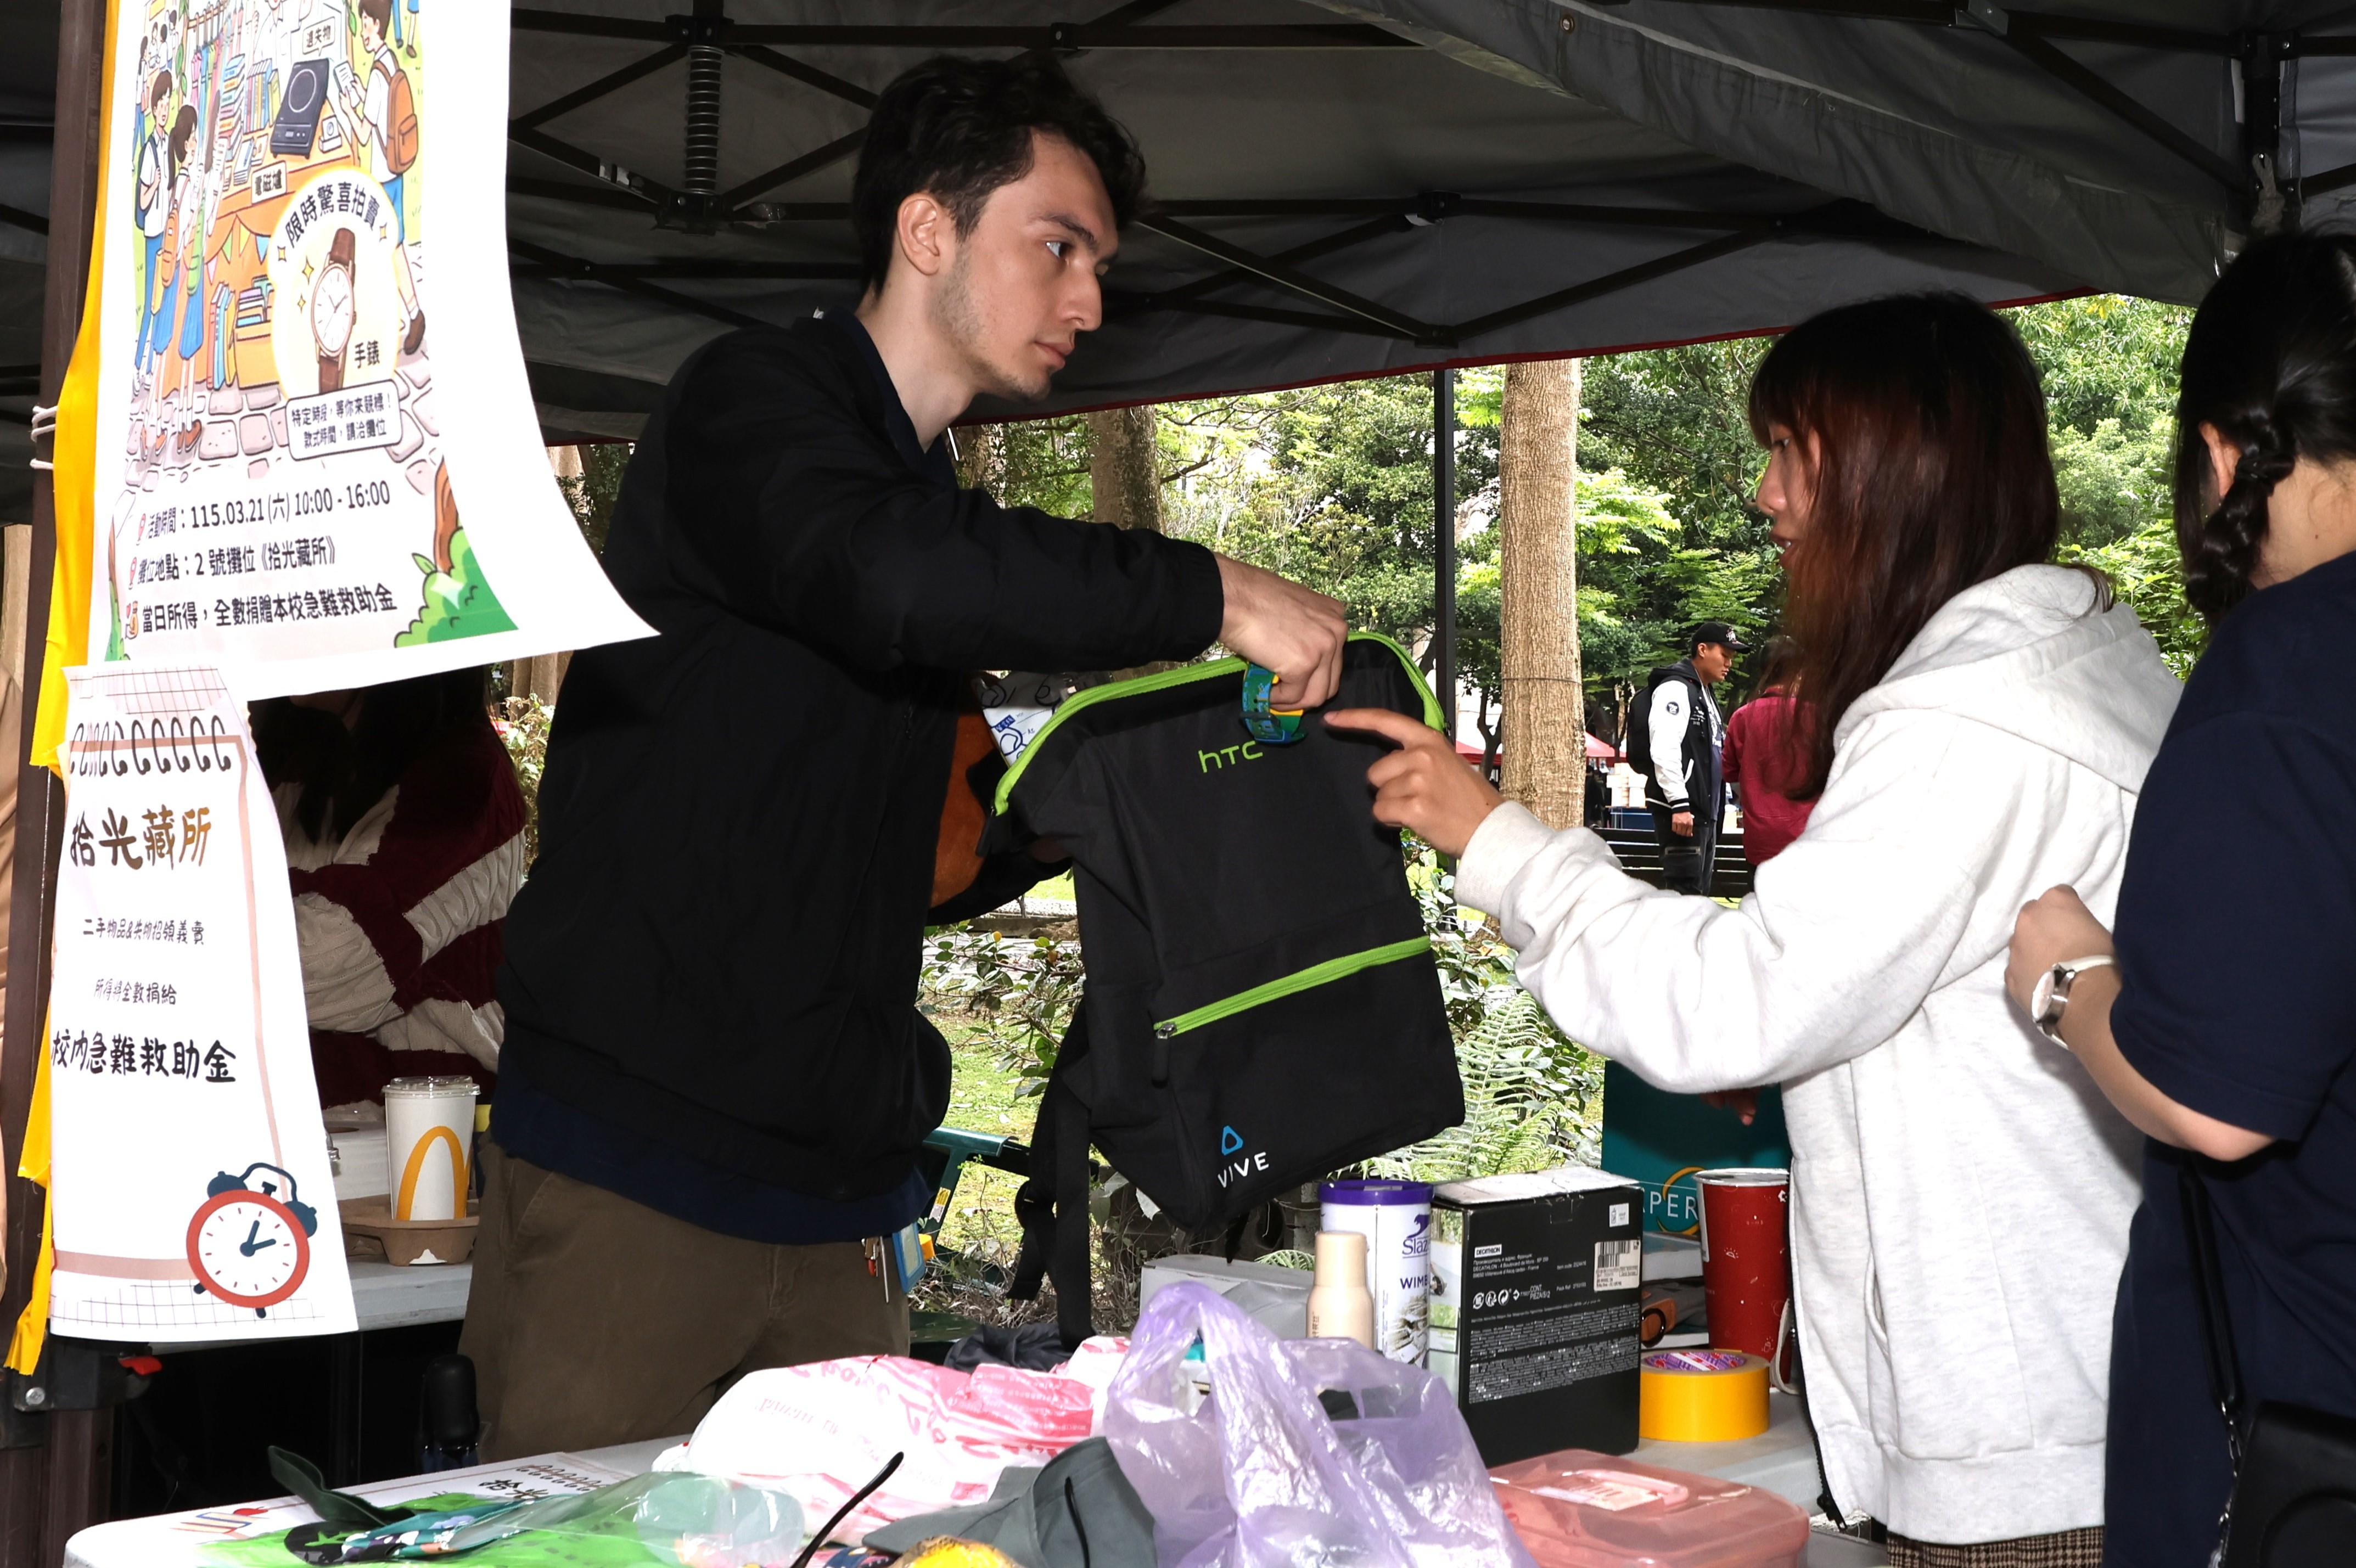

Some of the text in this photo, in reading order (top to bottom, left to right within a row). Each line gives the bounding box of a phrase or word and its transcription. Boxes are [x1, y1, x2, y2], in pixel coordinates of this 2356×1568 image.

[285, 181, 380, 248] 限時驚喜拍賣
[355, 340, 380, 369] 手錶
[70, 803, 211, 870] 拾光藏所
[1218, 1151, 1269, 1188] VIVE
[1476, 1246, 1500, 1256] DECATHLON
